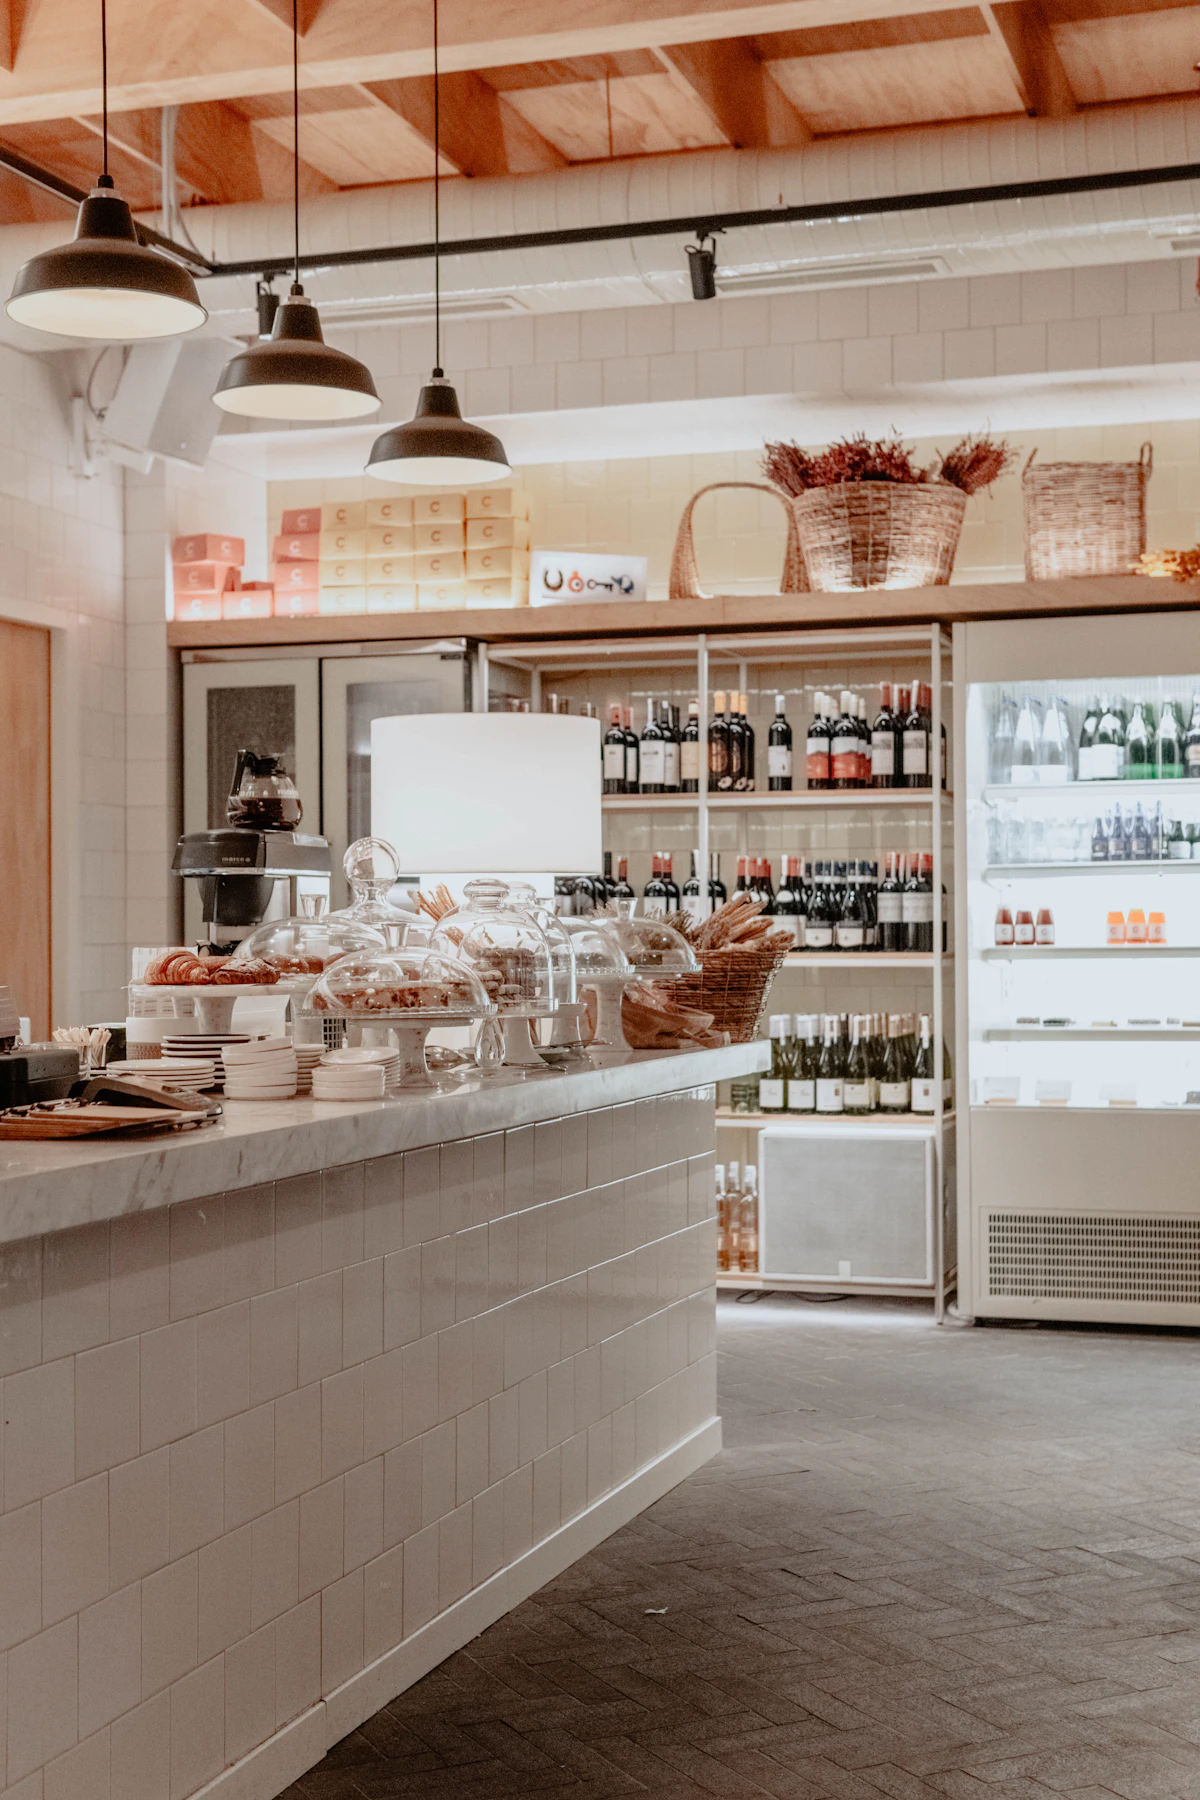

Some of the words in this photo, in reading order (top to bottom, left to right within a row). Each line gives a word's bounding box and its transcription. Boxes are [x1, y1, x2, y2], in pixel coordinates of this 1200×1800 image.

[430, 501, 440, 512] C
[482, 496, 492, 508] C
[336, 508, 346, 521] C
[381, 504, 392, 516] C
[430, 530, 441, 542] C
[482, 526, 493, 538] C
[336, 536, 345, 548] C
[382, 533, 392, 545] C
[290, 541, 300, 553] C
[382, 562, 392, 574] C
[430, 560, 440, 571] C
[482, 556, 492, 568] C
[291, 568, 303, 582] C
[335, 566, 345, 577] C
